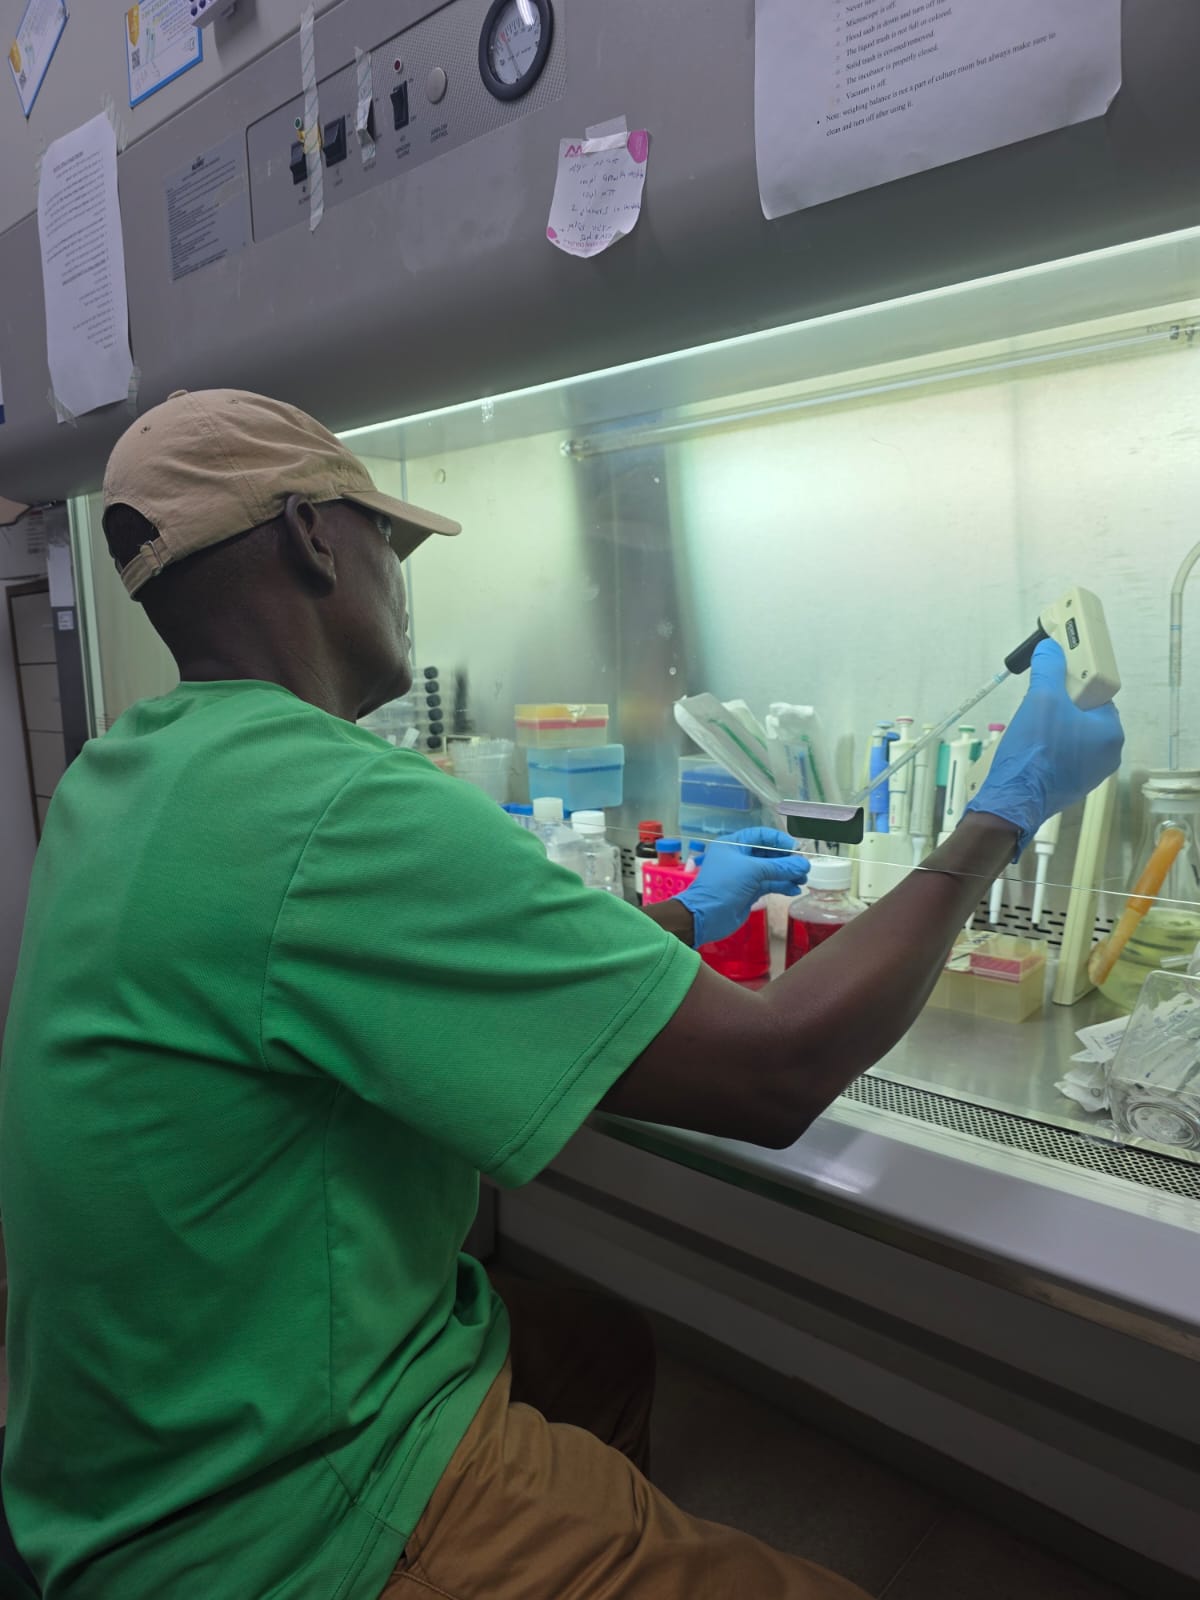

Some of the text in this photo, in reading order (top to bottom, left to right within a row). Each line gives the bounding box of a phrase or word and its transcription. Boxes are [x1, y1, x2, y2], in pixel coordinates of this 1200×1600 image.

[846, 11, 878, 27] Microscope
[883, 16, 899, 27] down
[901, 9, 911, 19] and
[912, 6, 925, 15] turn
[925, 0, 935, 8] off
[847, 48, 857, 56] The
[858, 40, 875, 52] liquid
[891, 32, 897, 40] is
[898, 26, 907, 36] not
[842, 102, 868, 116] weighing
[869, 93, 891, 105] balance
[899, 87, 909, 96] not
[914, 80, 927, 92] part
[927, 75, 935, 85] of
[935, 69, 957, 82] culture
[958, 62, 975, 73] room
[976, 57, 987, 66] but
[988, 47, 1011, 62] always
[1013, 41, 1032, 54] make
[1033, 35, 1048, 46] sure
[1048, 32, 1056, 40] to
[846, 59, 861, 70] Solid
[861, 54, 876, 64] trash
[847, 77, 857, 85] The
[858, 67, 884, 80] incubator
[893, 52, 917, 70] properly
[846, 87, 870, 99] Vacuum
[826, 127, 841, 136] clean
[842, 121, 852, 131] and
[853, 118, 865, 127] turn
[865, 112, 875, 121] off
[876, 110, 889, 119] after
[889, 103, 906, 114] using
